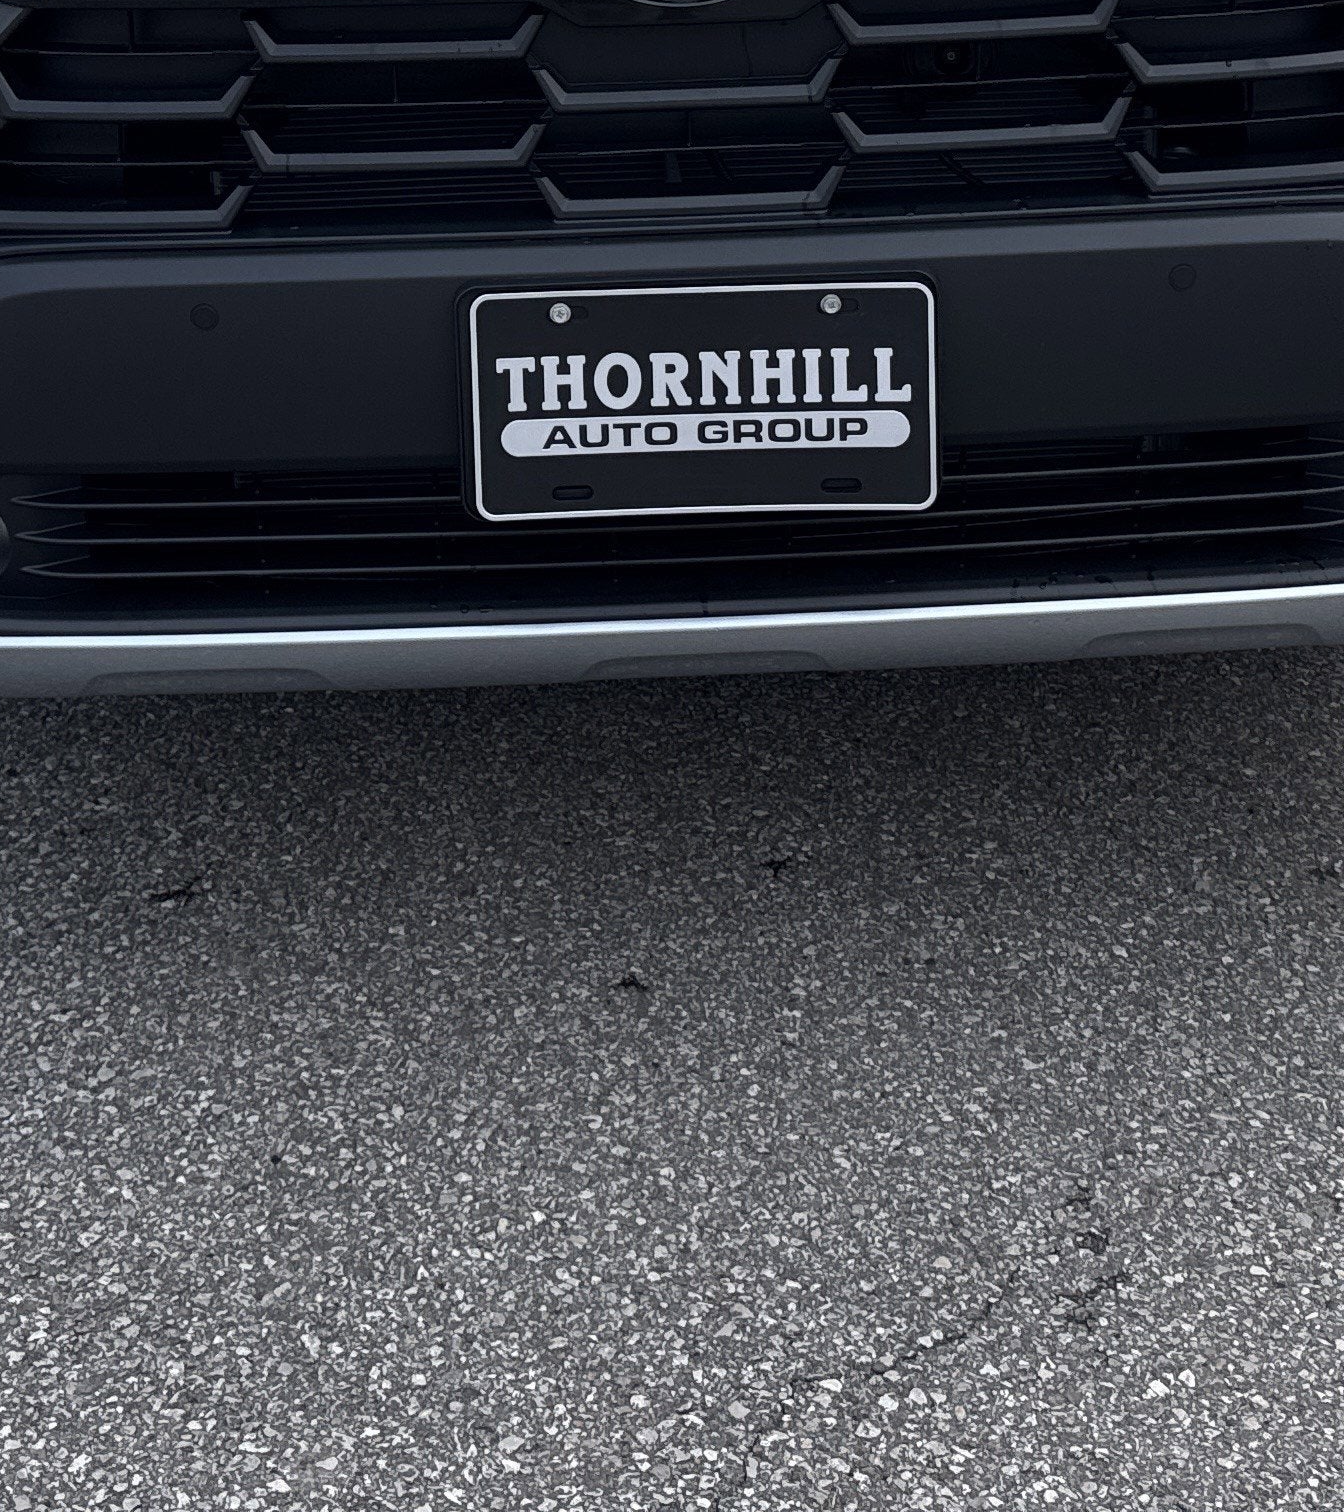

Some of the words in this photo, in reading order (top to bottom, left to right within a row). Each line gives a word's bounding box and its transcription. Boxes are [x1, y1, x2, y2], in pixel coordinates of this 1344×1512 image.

[495, 347, 912, 412] THORNHILL
[542, 421, 678, 449] AUTO
[696, 417, 869, 444] GROUP
